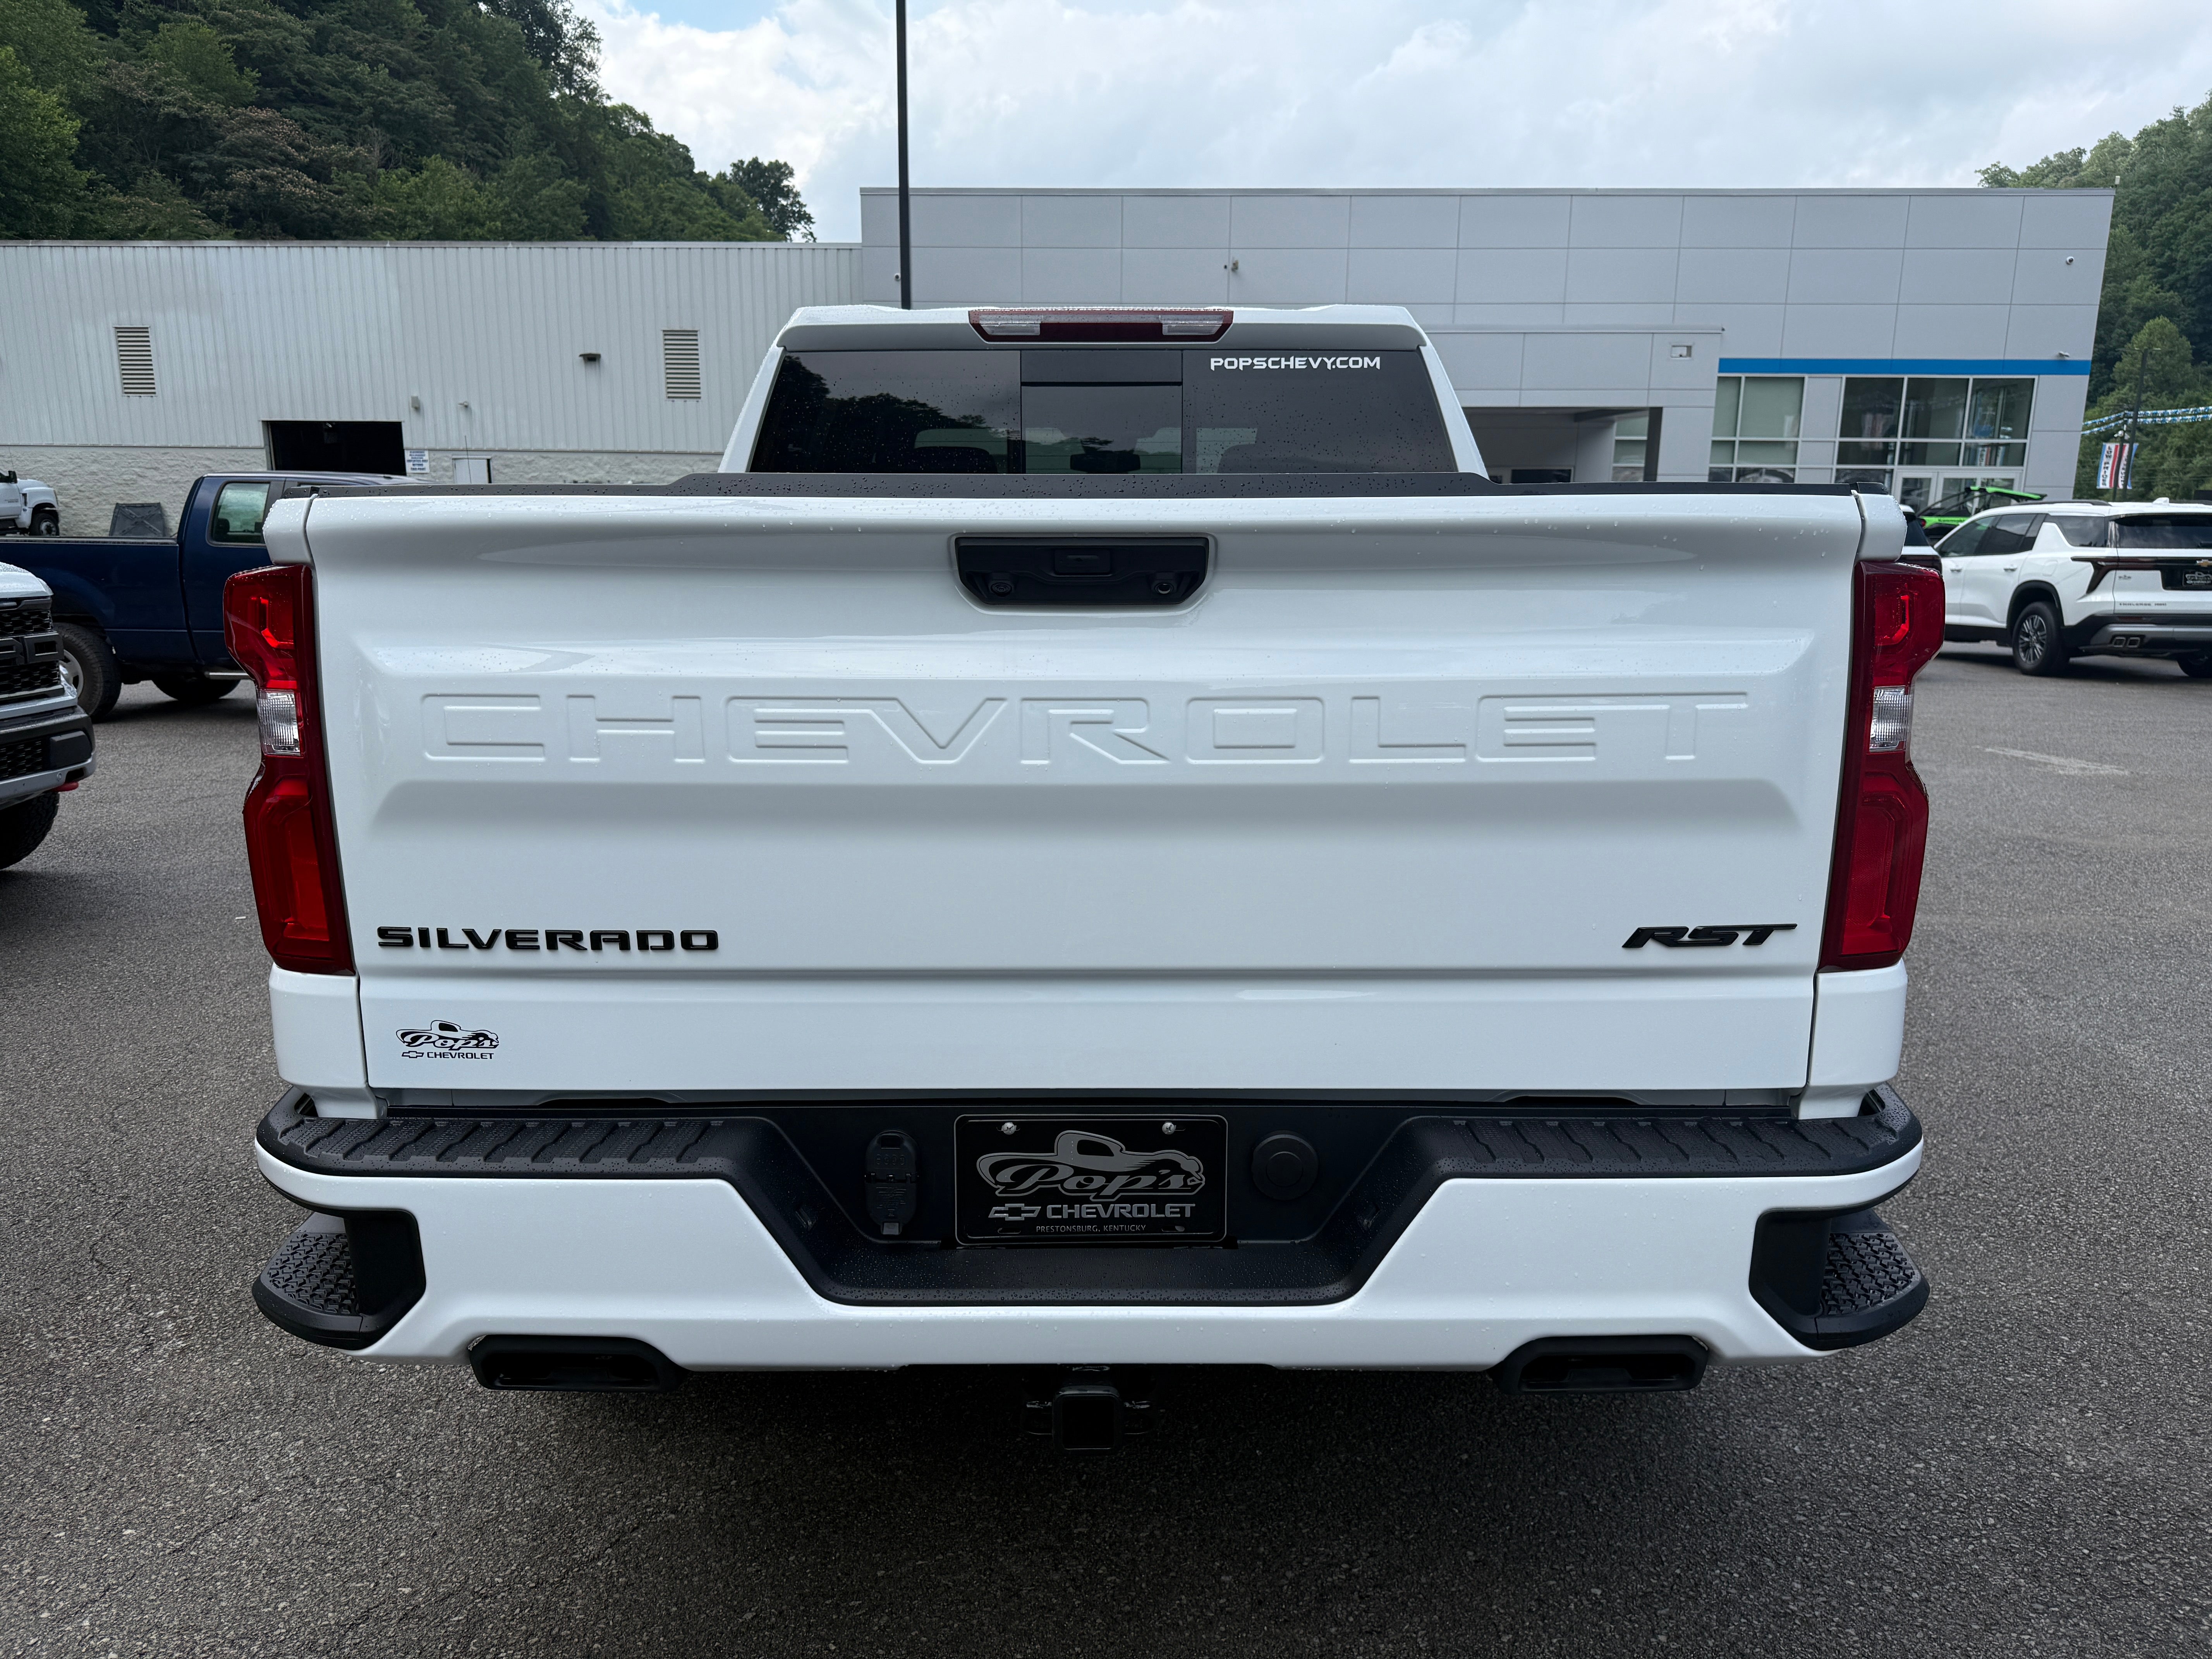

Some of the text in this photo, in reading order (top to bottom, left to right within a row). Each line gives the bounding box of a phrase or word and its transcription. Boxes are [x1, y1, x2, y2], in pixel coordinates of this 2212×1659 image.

[1211, 356, 1380, 371] POPSCHEVY.COM
[421, 691, 1749, 766] CHEVROLET
[377, 926, 719, 951] SILVERADO
[1622, 923, 1798, 948] RST
[427, 1051, 494, 1060] CHEVROLET
[996, 1164, 1191, 1195] Pop's
[1046, 1203, 1196, 1219] CHEVROLET
